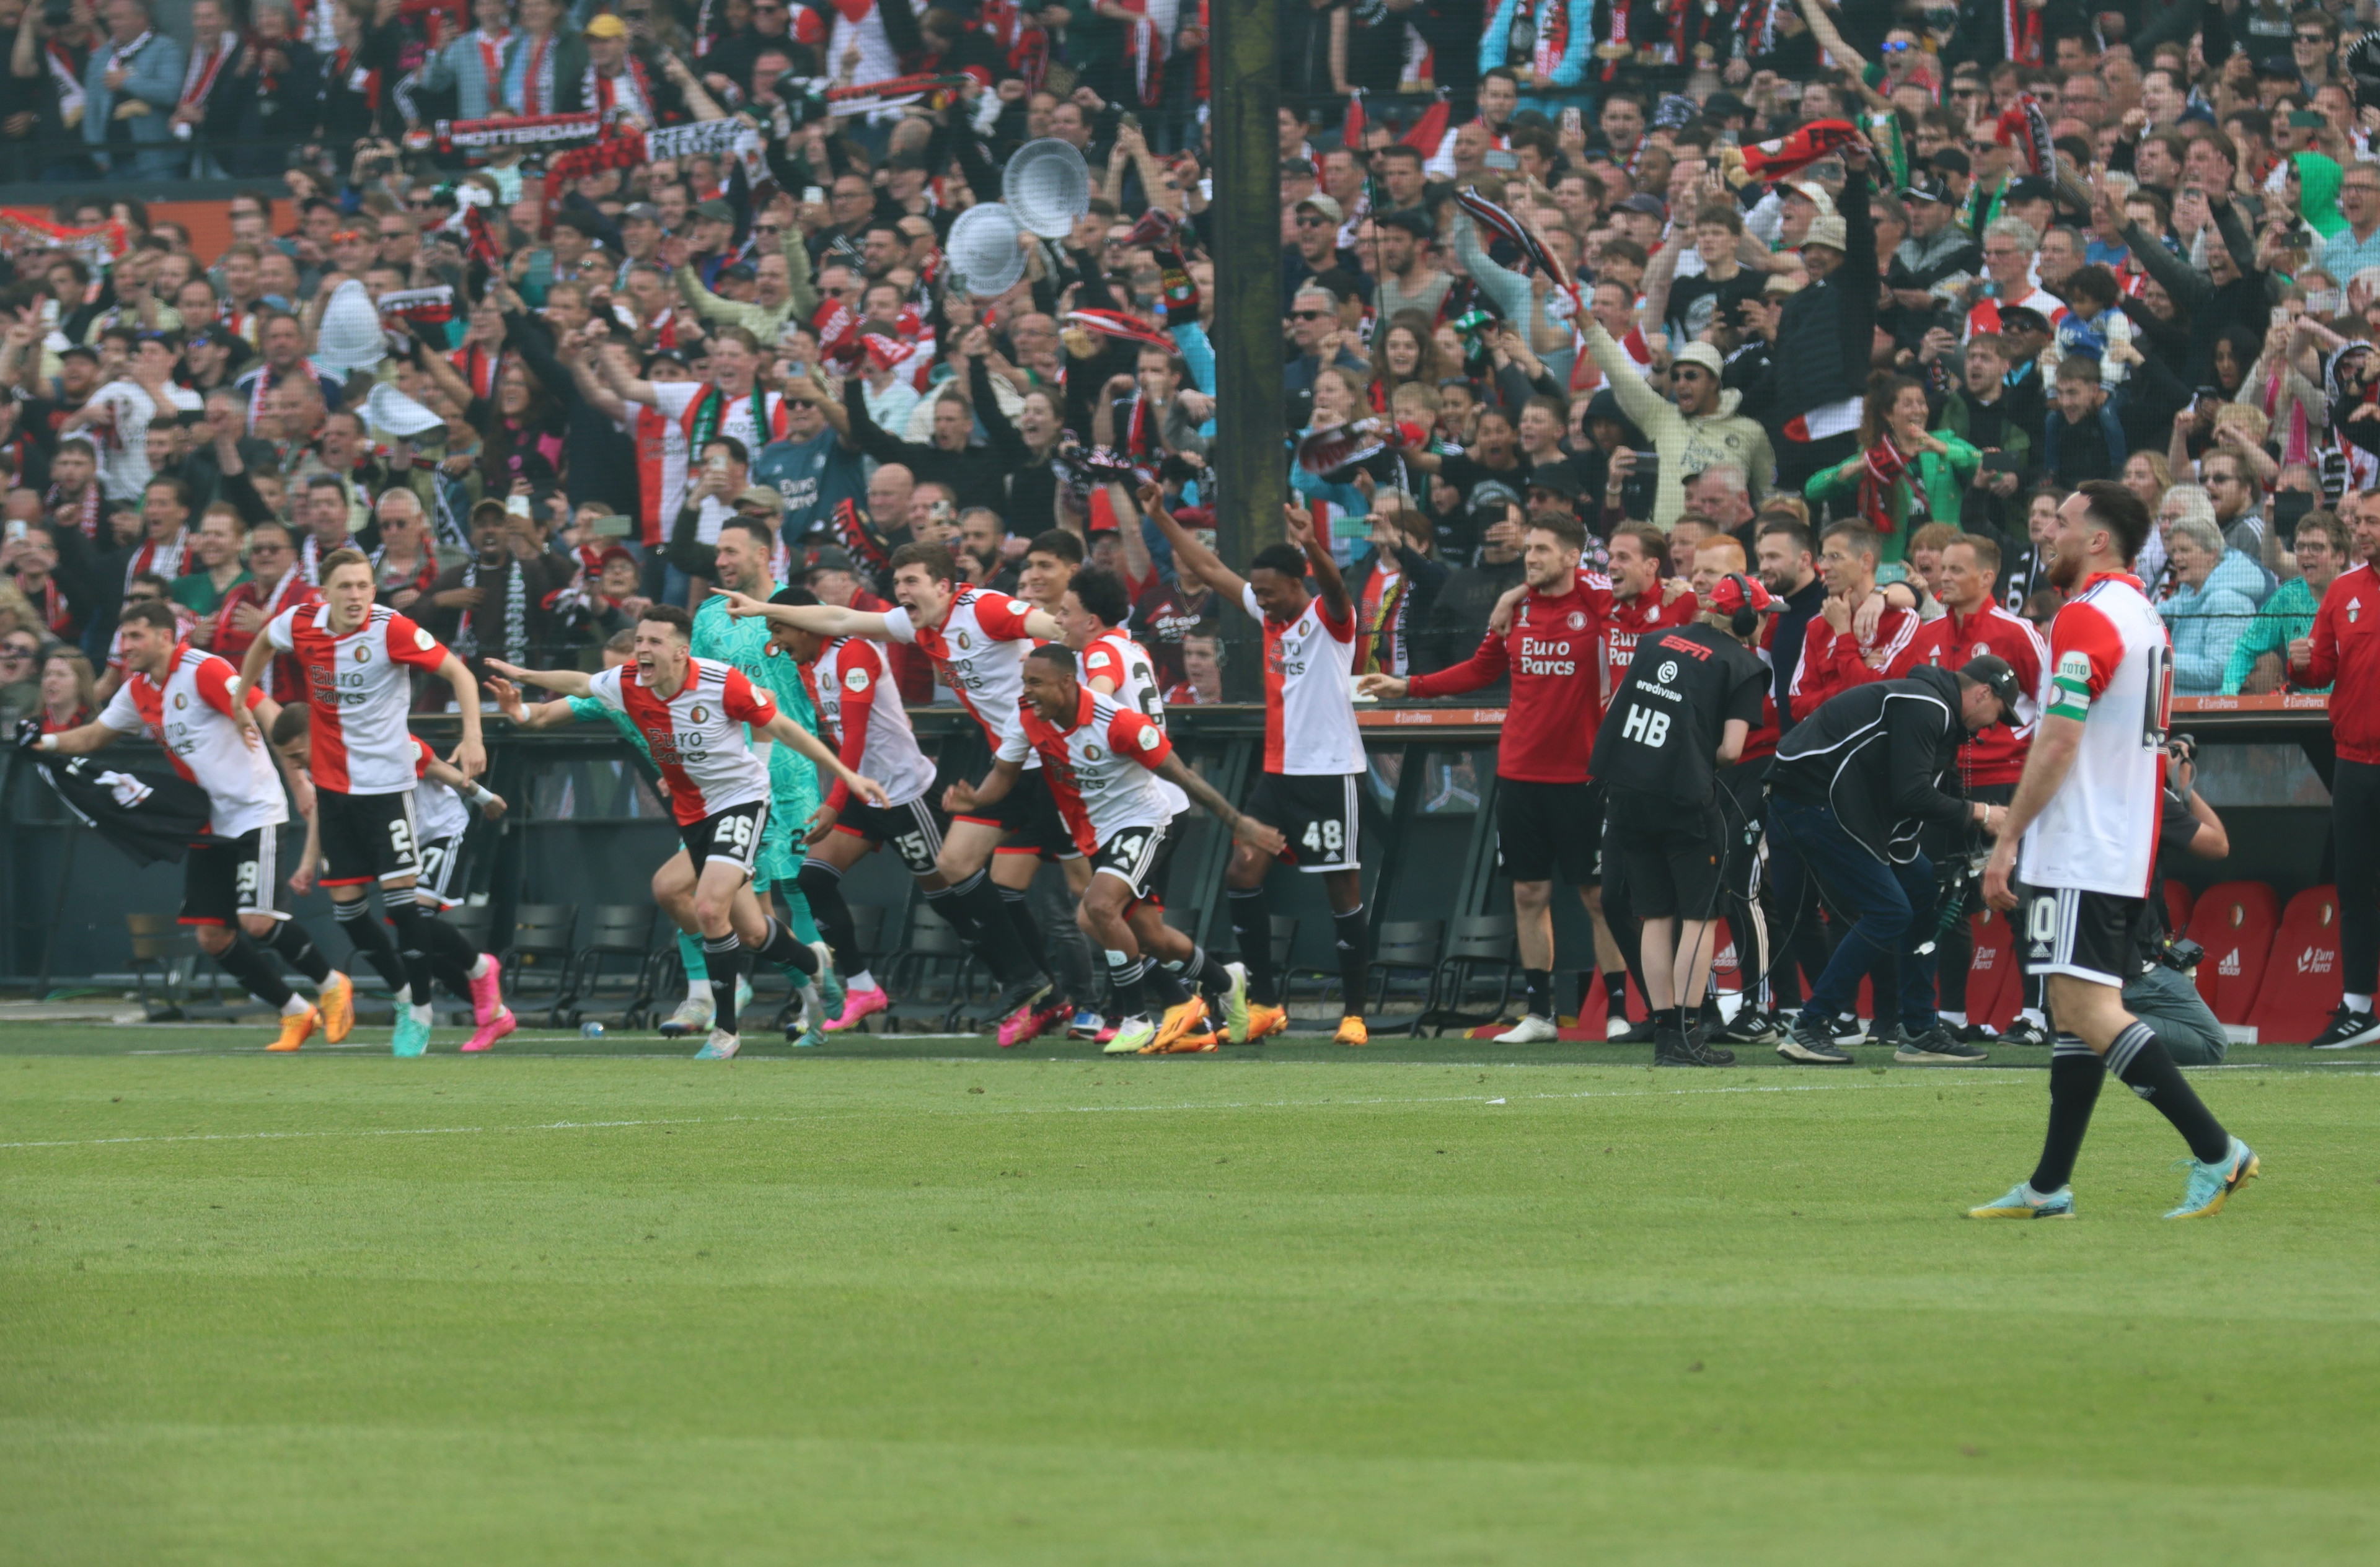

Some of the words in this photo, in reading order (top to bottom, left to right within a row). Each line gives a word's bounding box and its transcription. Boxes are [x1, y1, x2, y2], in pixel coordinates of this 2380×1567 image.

[1522, 636, 1570, 656] Euro
[1610, 631, 1641, 647] Eur
[1659, 634, 1713, 661] ESPN
[1520, 656, 1575, 675] Parcs
[1608, 647, 1636, 666] Par
[310, 665, 364, 687] Euro
[2063, 662, 2087, 675] TOTO
[847, 674, 866, 683] TOTO
[314, 688, 367, 704] Parcs
[1636, 680, 1682, 702] eredivisie
[2205, 698, 2238, 709] EuroParcs
[2291, 696, 2324, 708] EuroParcs
[1401, 713, 1433, 723] EuroParcs
[1481, 712, 1506, 722] EuroPar
[1622, 703, 1671, 748] HB
[647, 727, 702, 747] Euro
[389, 819, 413, 852] 2
[714, 815, 754, 848] 26
[1302, 820, 1344, 853] 48
[894, 830, 928, 859] 15
[1111, 834, 1144, 863] 14
[1713, 958, 1739, 967] adidas
[1975, 947, 1996, 959] Euro
[2314, 947, 2335, 960] Euro
[2309, 960, 2332, 973] Parcs
